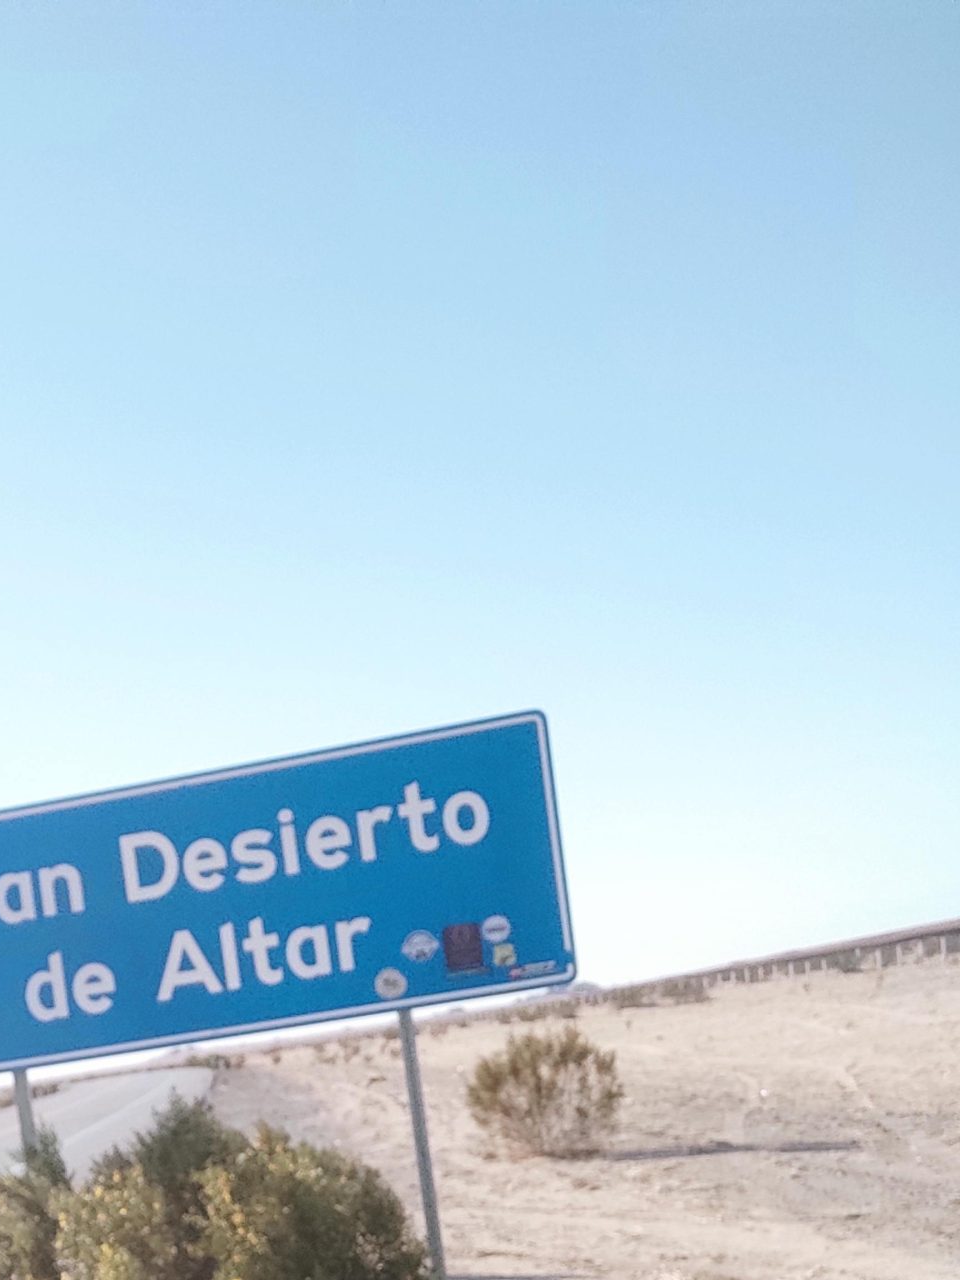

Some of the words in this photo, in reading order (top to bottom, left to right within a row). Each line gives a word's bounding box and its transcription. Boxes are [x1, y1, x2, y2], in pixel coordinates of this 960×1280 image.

[119, 780, 490, 903] Desierto
[24, 952, 116, 1022] de
[156, 913, 371, 1002] Altar
